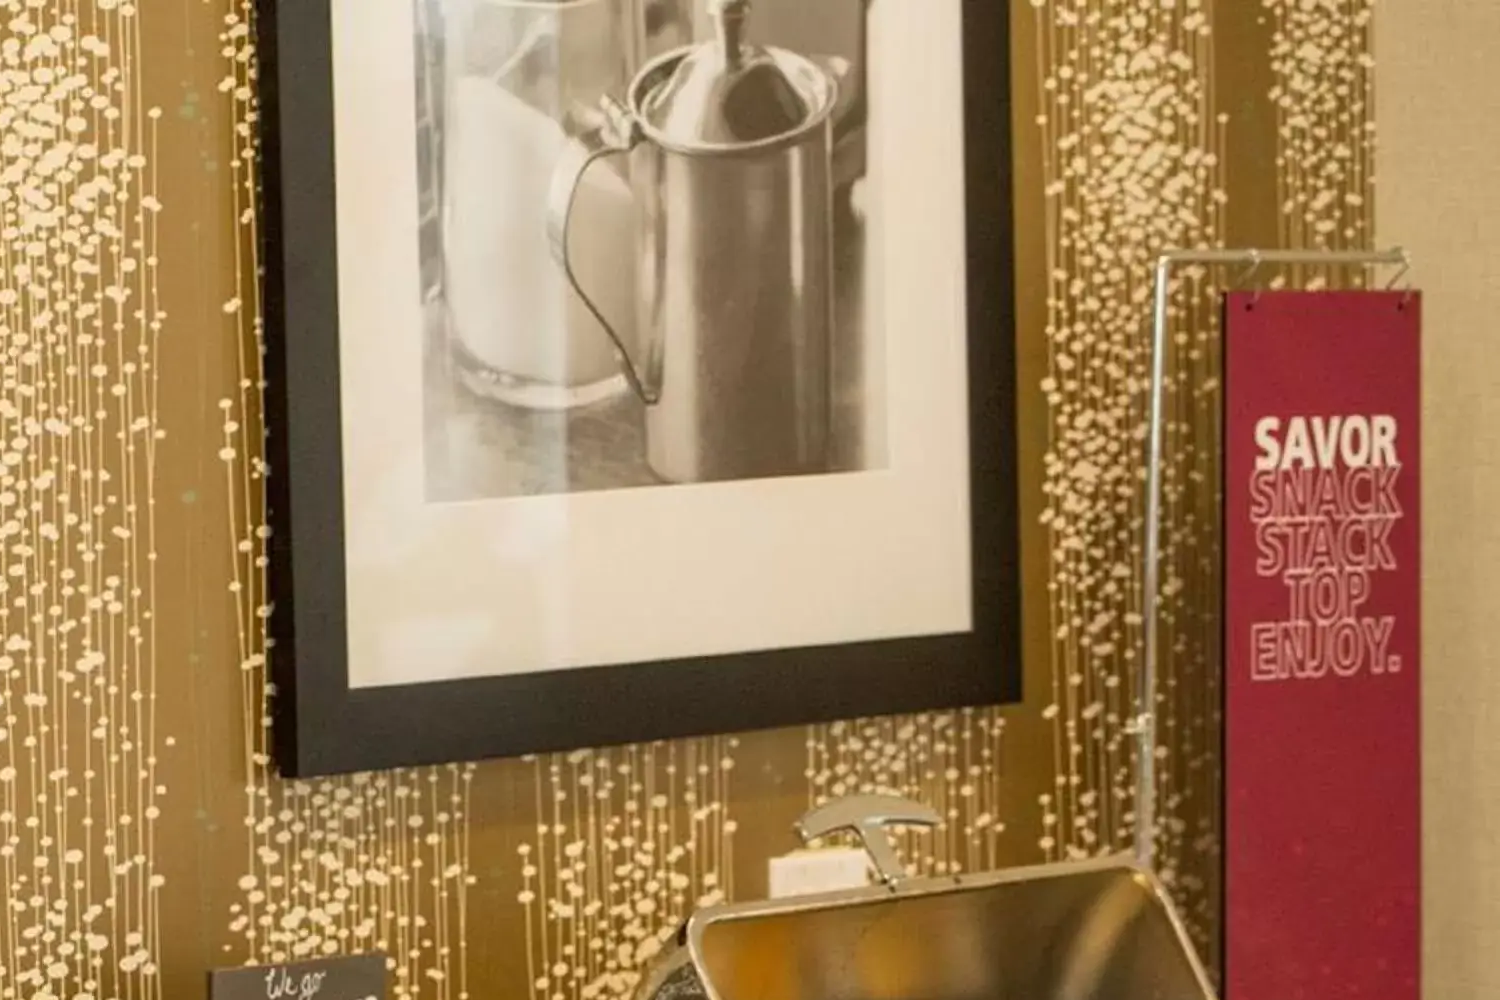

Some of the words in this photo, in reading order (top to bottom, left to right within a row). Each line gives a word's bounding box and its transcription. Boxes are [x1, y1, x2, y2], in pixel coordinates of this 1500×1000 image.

[1254, 415, 1397, 469] SAVOR
[1250, 464, 1403, 522] SNACK
[1255, 516, 1397, 576] STACK
[1284, 566, 1370, 627] TOP
[1251, 616, 1402, 680] ENJOY.
[265, 967, 298, 999] We
